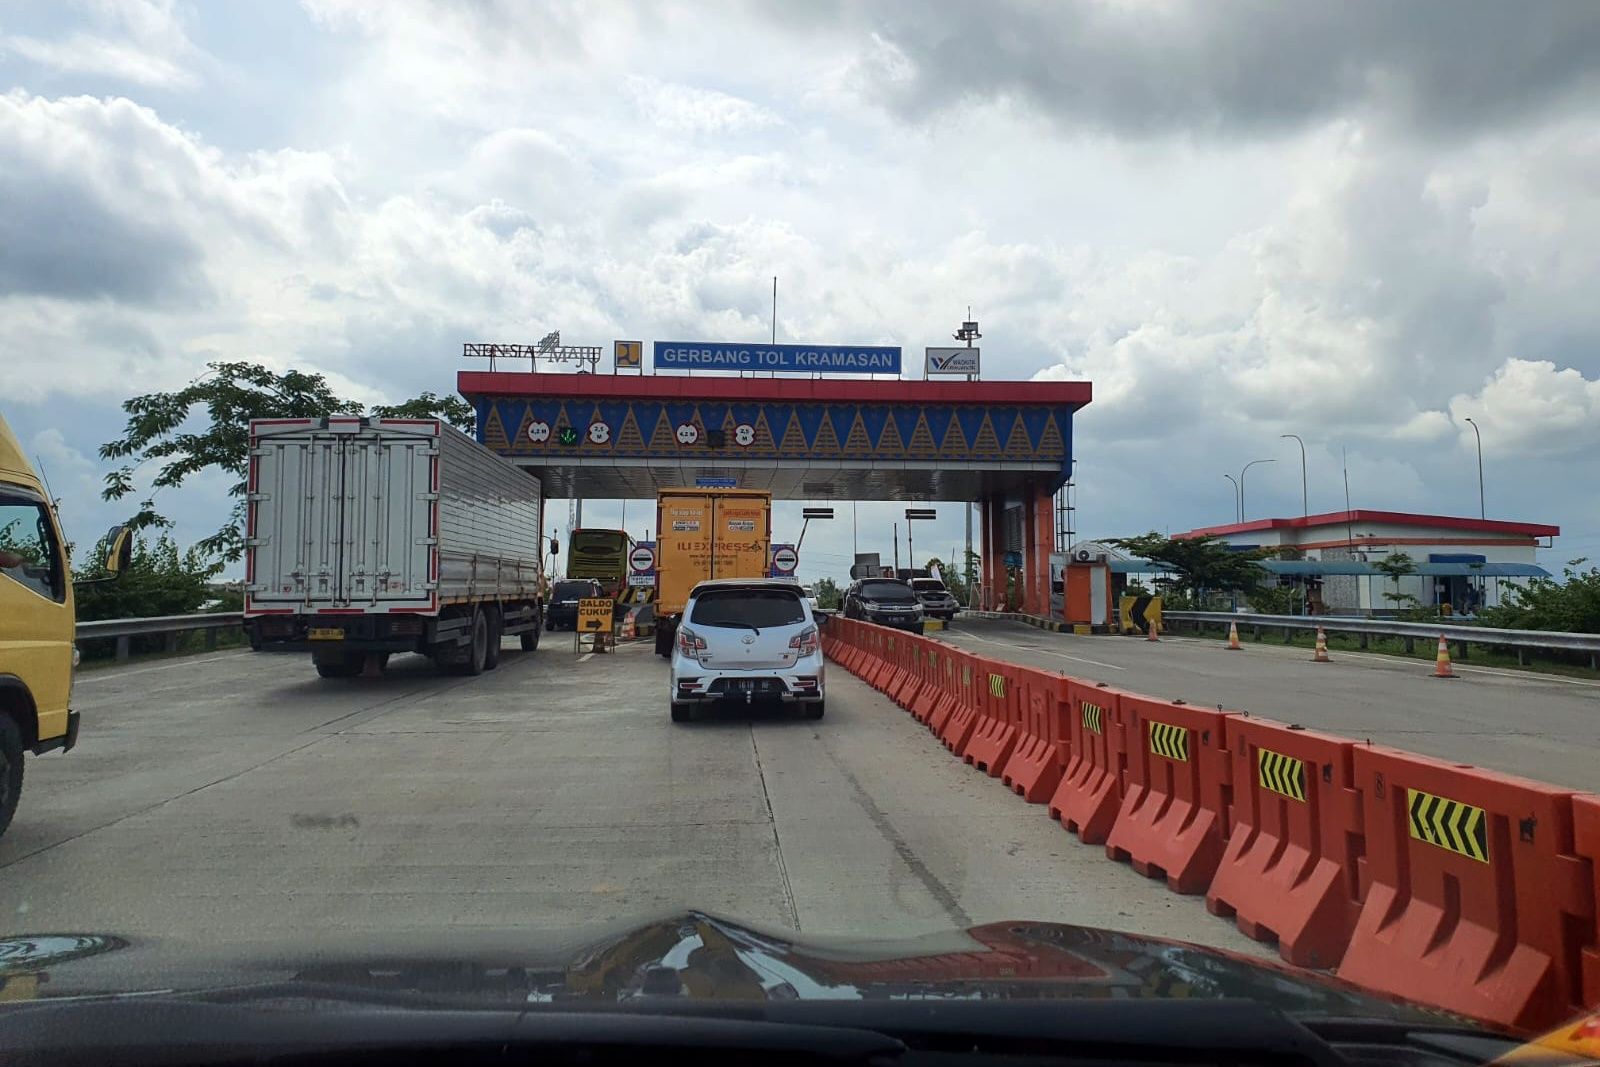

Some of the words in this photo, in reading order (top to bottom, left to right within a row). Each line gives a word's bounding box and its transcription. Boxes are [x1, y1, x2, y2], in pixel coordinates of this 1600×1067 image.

[663, 348, 750, 364] GERBANG
[756, 350, 788, 365] TOL
[795, 351, 893, 367] KRAMASAN
[580, 600, 612, 608] SALDO
[579, 608, 611, 616] CUKUP
